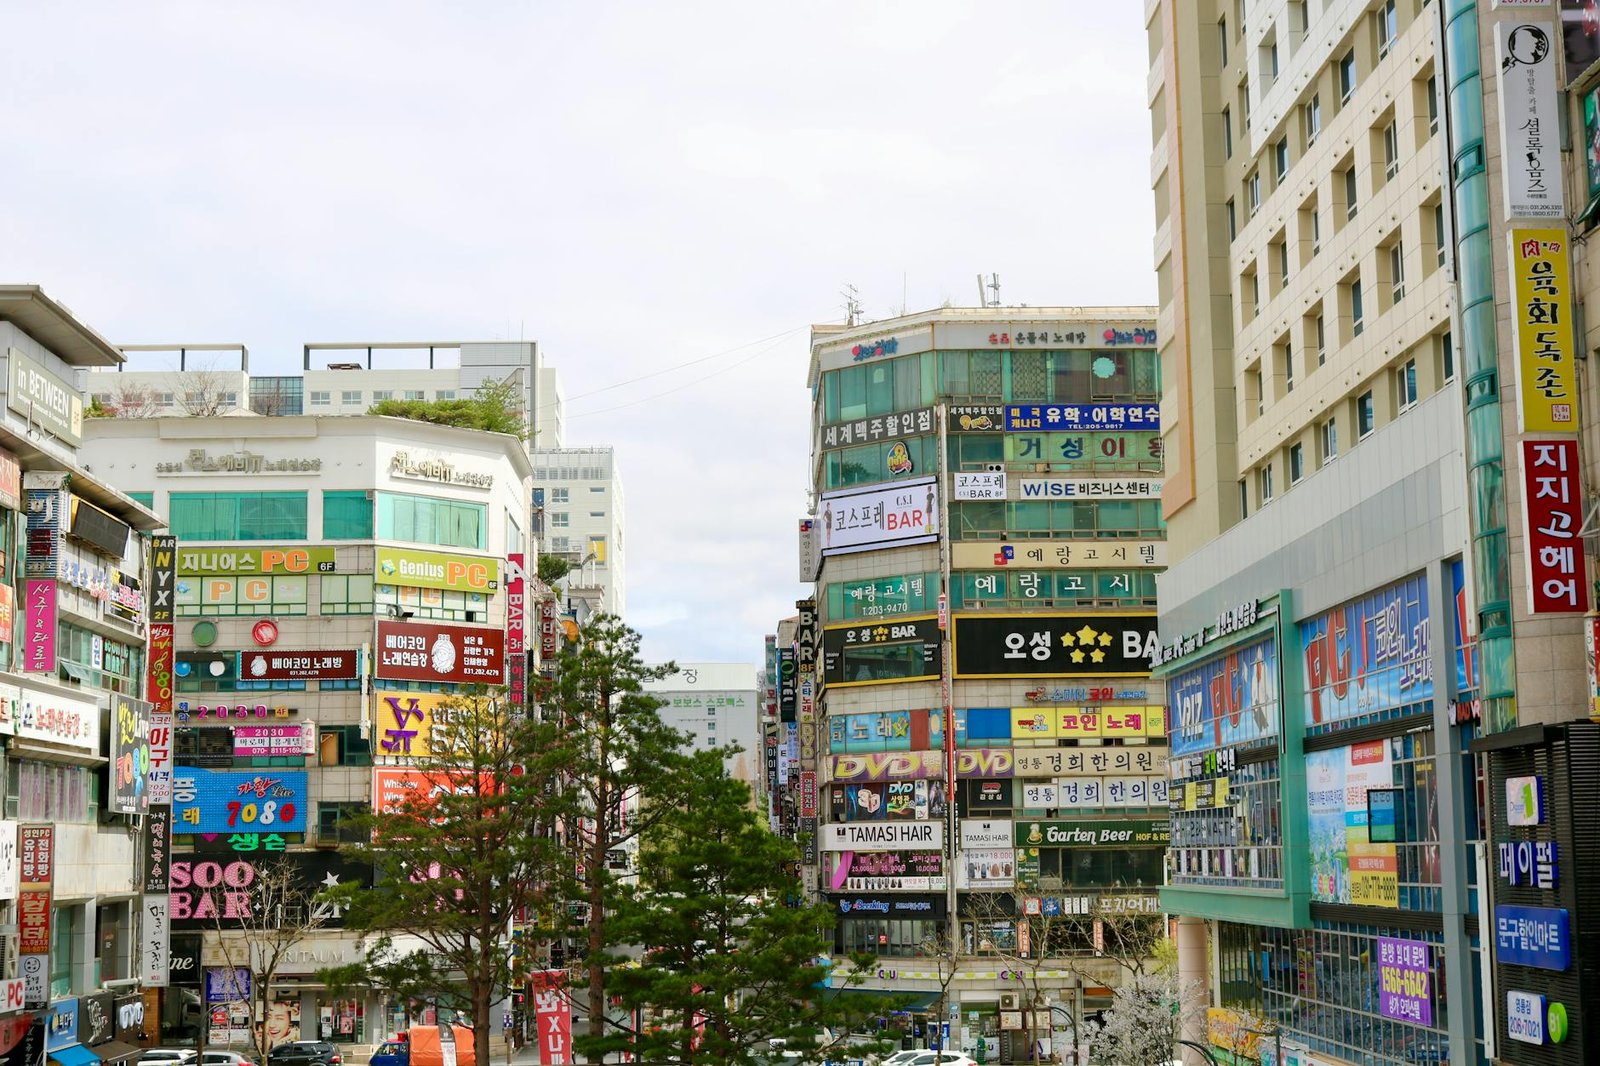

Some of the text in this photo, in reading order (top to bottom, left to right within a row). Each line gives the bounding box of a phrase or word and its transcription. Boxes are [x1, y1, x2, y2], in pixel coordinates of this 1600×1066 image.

[1518, 117, 1548, 193] 셜록홈즈
[17, 361, 27, 391] in
[29, 368, 70, 419] BETWEEN
[824, 409, 931, 446] 세계맥주할인점
[958, 475, 1004, 488] 코스프레
[970, 489, 992, 499] BAR
[834, 500, 885, 531] 코스프레
[887, 509, 923, 531] BAR
[1533, 444, 1577, 606] 지지고헤어
[153, 539, 175, 548] BAR
[181, 549, 333, 573] 지니어스 PC 6F
[154, 551, 171, 606] NYX
[399, 558, 444, 579] Genius
[446, 560, 488, 589] PC
[974, 572, 1157, 599] 예랑고시
[154, 611, 170, 620] 2F
[509, 593, 523, 631] BAR
[386, 634, 426, 649] 베어코인
[510, 638, 522, 650] 3F
[800, 611, 814, 661] BAR
[846, 625, 917, 643] 오성 BAR
[1003, 630, 1052, 661] 오성
[1122, 630, 1159, 659] BA
[1375, 597, 1433, 690] 코인 노래
[34, 661, 46, 669] 4F
[271, 657, 343, 669] 베어코인 노래방
[382, 651, 428, 667] 노래연습장
[800, 663, 815, 672] 8F
[1305, 605, 1352, 724] PC
[1088, 687, 1114, 701] 코인
[1209, 653, 1243, 747] PC
[197, 704, 268, 720] 2030
[275, 706, 288, 717] 4F
[1062, 714, 1142, 731] 코인 노래
[255, 728, 284, 737] 2030
[851, 716, 893, 740] 노래
[150, 727, 170, 768] 야구
[833, 755, 921, 780] DVD
[957, 750, 1013, 777] DVD
[1018, 751, 1153, 773] 영통 경희한의원
[383, 778, 419, 790] Whiskey
[888, 781, 914, 796] DVD
[1027, 787, 1055, 802] 영통
[1062, 780, 1168, 804] 경희한의원
[383, 791, 404, 802] Wine
[857, 788, 881, 813] 3D
[171, 806, 200, 824] 래
[226, 799, 297, 828] 7080
[848, 825, 933, 843] TAMASI HAIR
[965, 834, 1009, 842] TAMASI HAIR
[1046, 825, 1133, 845] Garten Beer
[1135, 833, 1170, 841] HOF & RE
[37, 838, 49, 877] 전화방
[169, 860, 255, 888] SOO
[169, 891, 252, 919] BAR
[1101, 897, 1163, 913] 포차어게
[22, 900, 46, 940] 컴퓨터
[1498, 916, 1561, 953] 문구할인마트
[169, 950, 194, 970] ine
[284, 950, 346, 964] RITAUM
[1381, 942, 1426, 968] 분양 임대 문의
[7, 981, 23, 1009] PC
[1381, 967, 1428, 999] 1566-6642
[1388, 995, 1421, 1019] 상가 오피스텔
[1515, 998, 1531, 1015] 영통점
[1509, 1015, 1541, 1039] 206-7021
[1550, 1011, 1561, 1031] B1
